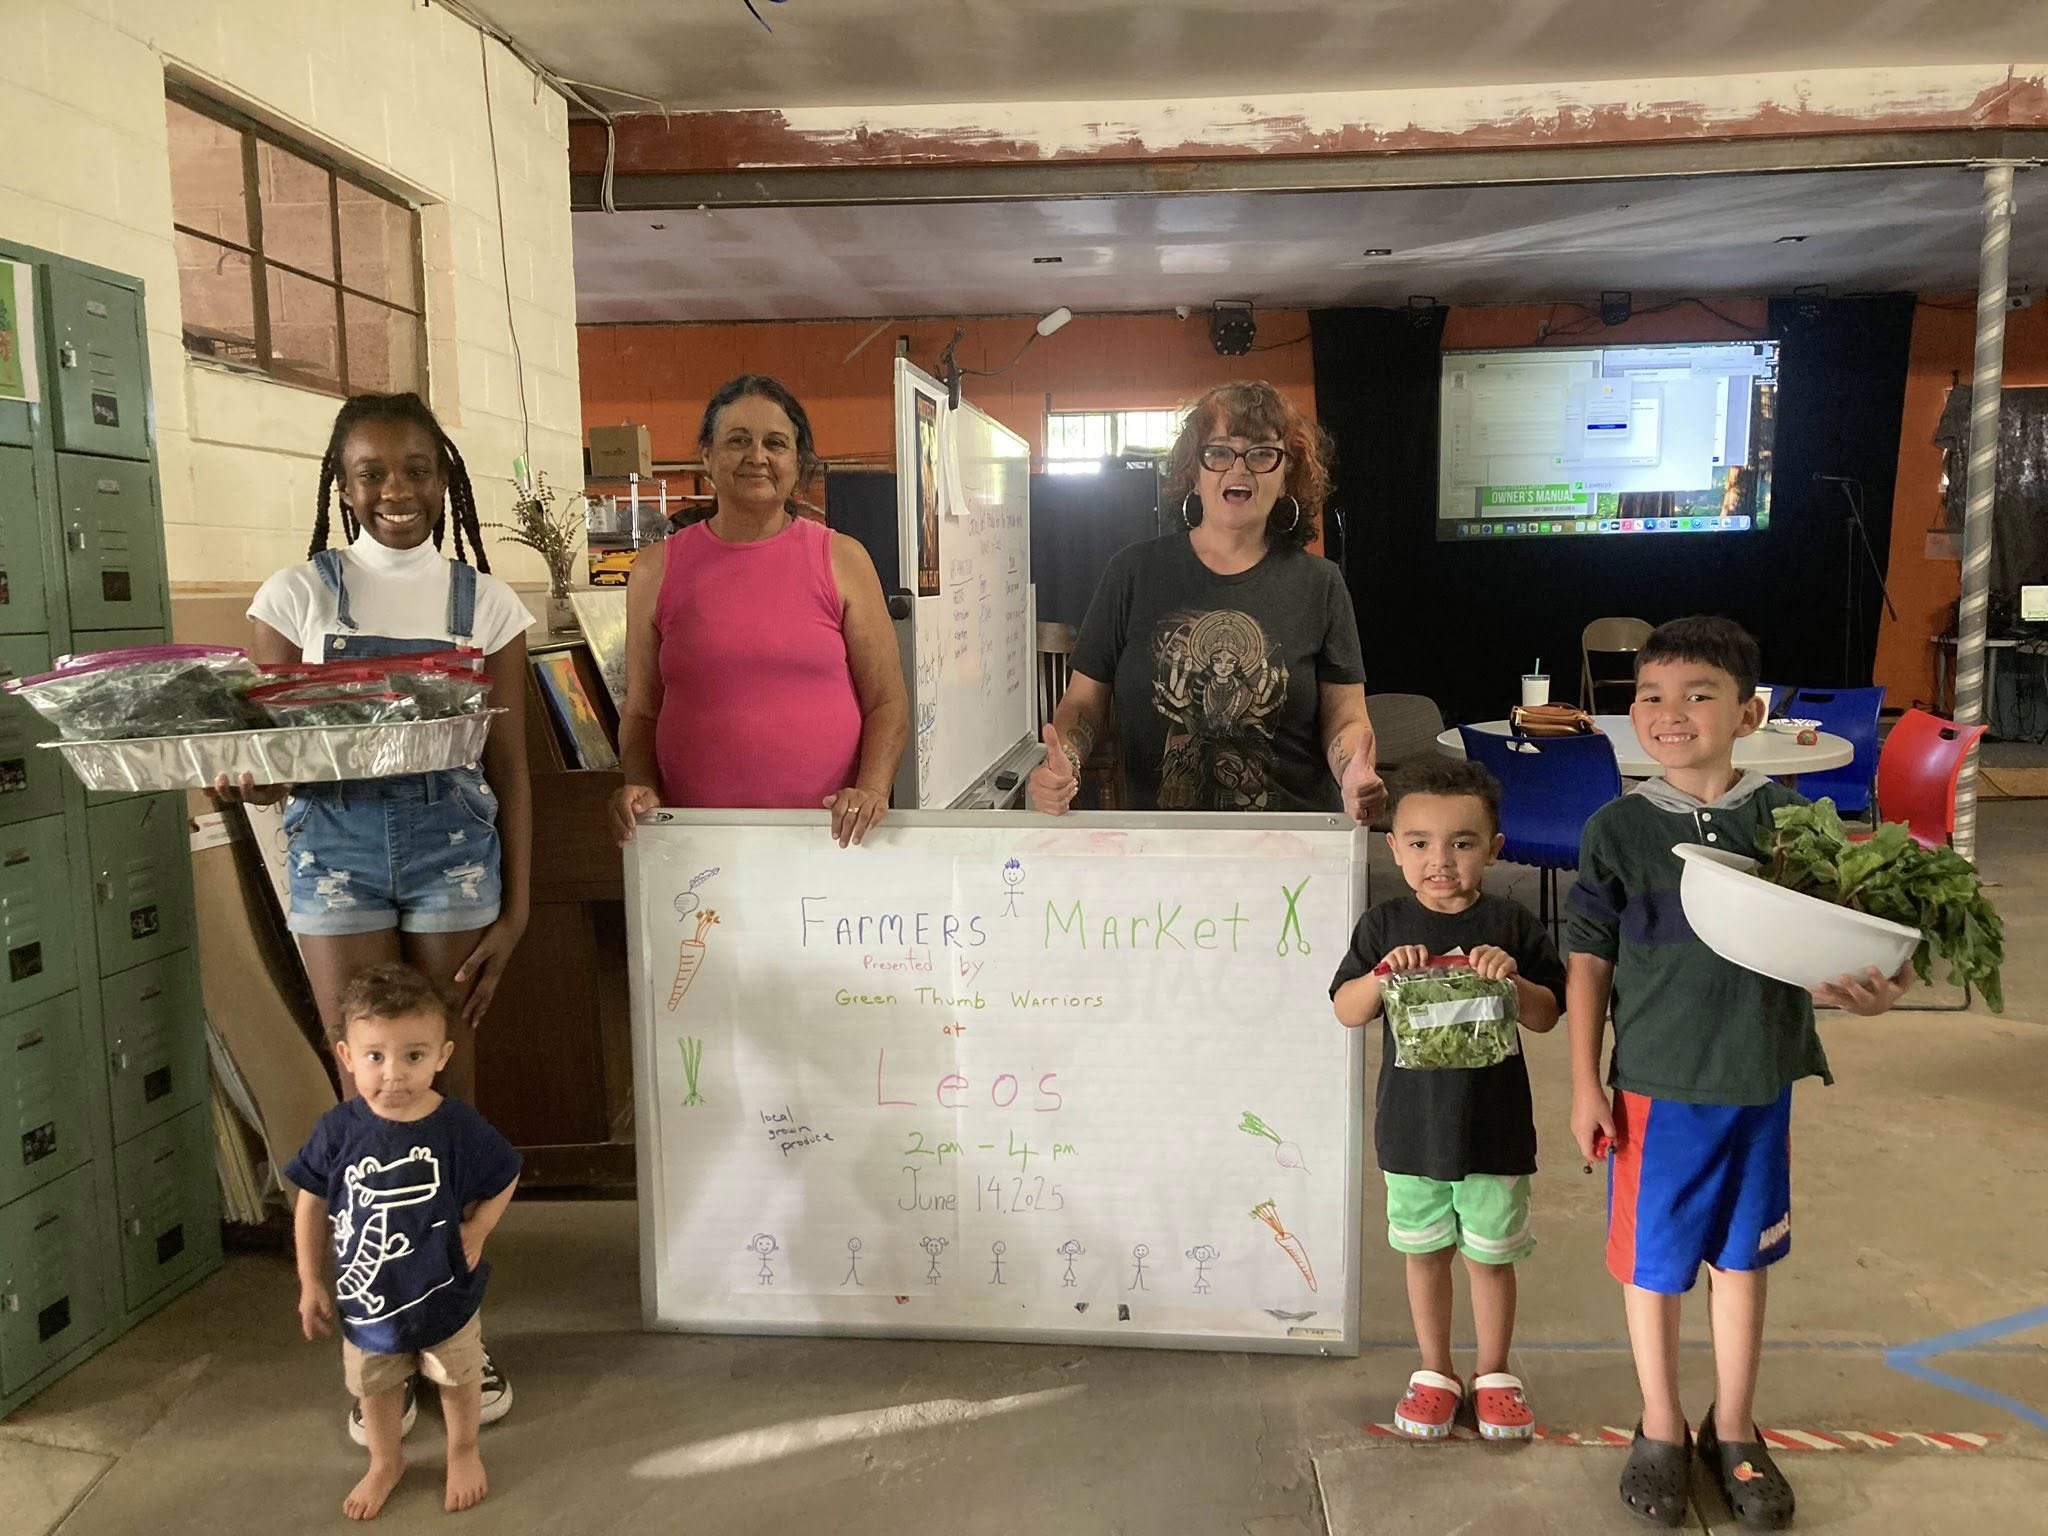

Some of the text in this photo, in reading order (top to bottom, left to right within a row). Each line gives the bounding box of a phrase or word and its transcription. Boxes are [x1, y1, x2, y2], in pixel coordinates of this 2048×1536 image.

[1492, 489, 1576, 504] OWNER'S MANUAL
[863, 947, 933, 972] Presented
[835, 989, 897, 1006] Green
[914, 987, 986, 1009] Thumb
[943, 1022, 966, 1037] at
[760, 1105, 794, 1124] local
[768, 1125, 812, 1140] grown
[781, 1133, 834, 1157] produce
[898, 1166, 957, 1211] June
